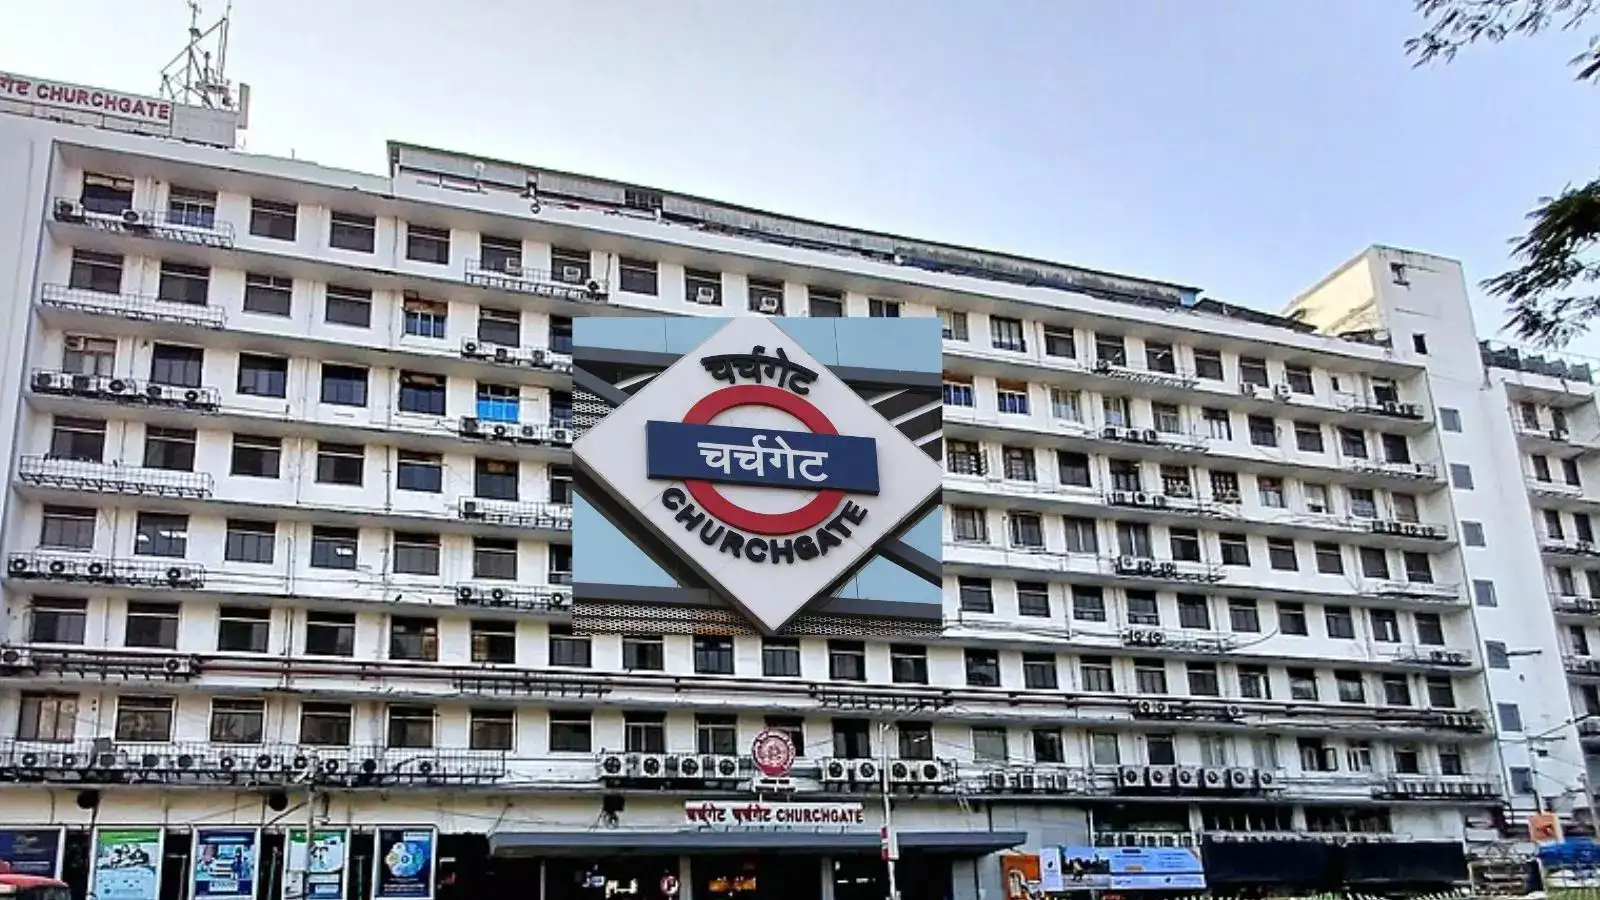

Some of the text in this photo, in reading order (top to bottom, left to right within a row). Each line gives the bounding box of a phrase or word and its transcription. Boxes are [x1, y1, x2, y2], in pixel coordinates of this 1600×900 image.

[37, 84, 170, 120] CHURCHGATE
[700, 345, 819, 395] चर्चगेट
[697, 435, 829, 482] चर्चगेट
[661, 488, 869, 564] CHURCHGATE
[775, 808, 864, 824] CHURCHGATE
